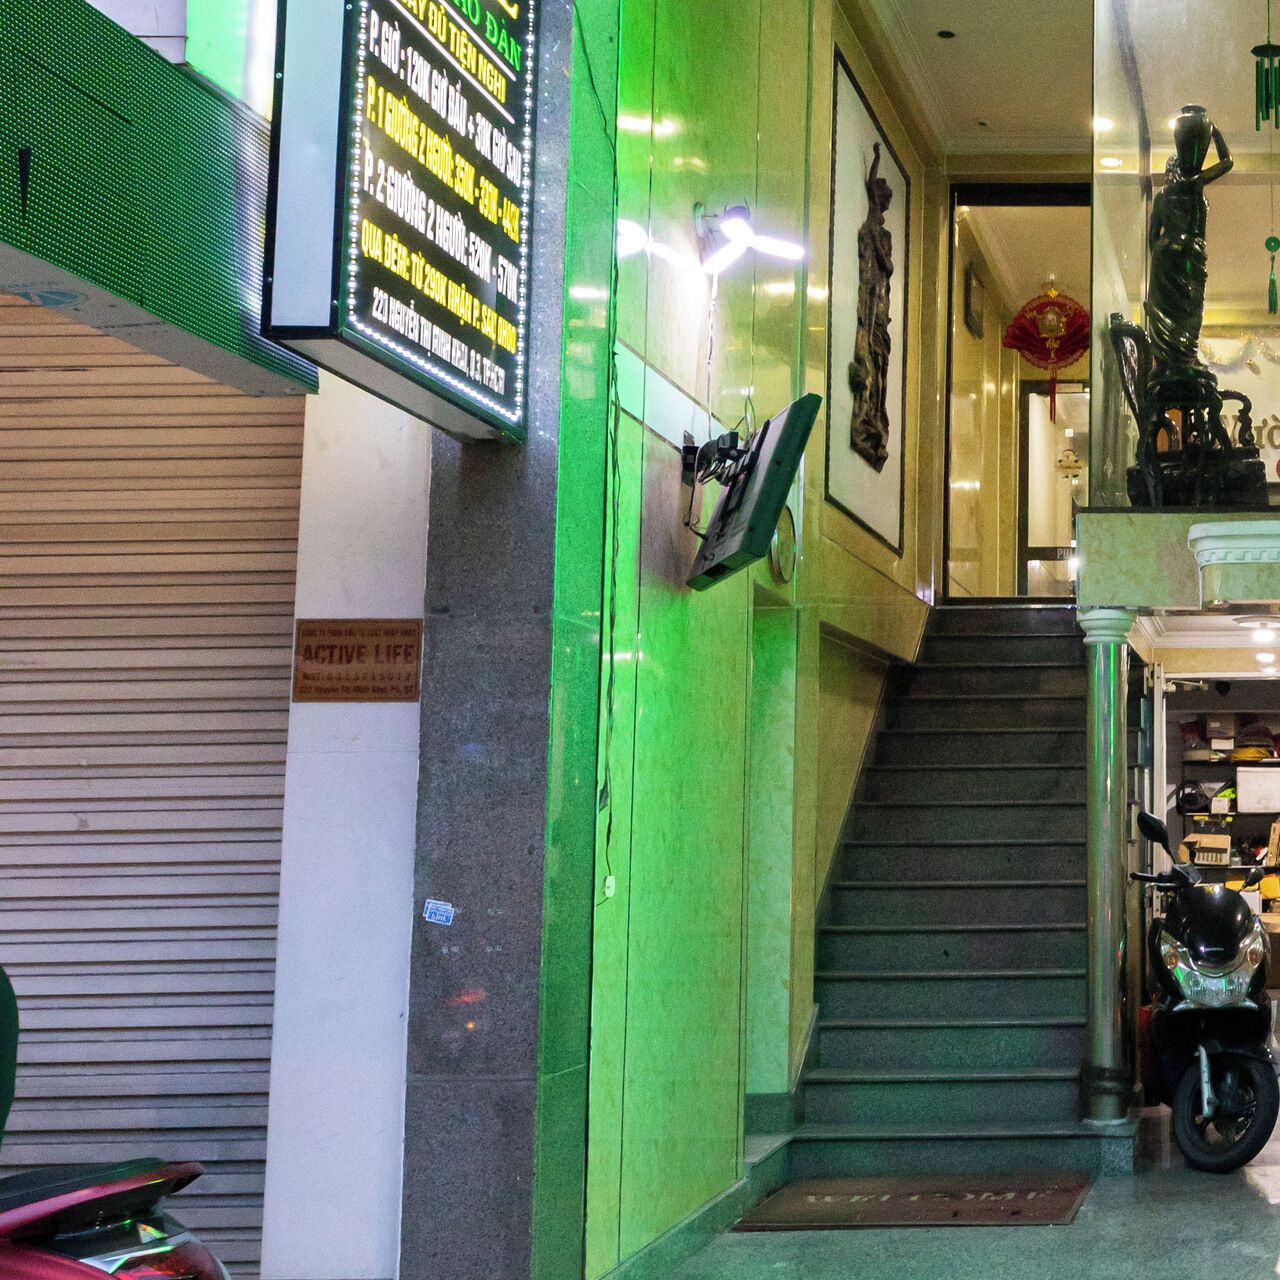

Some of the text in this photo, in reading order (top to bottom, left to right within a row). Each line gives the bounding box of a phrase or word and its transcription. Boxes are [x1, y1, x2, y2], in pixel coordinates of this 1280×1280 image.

[381, 21, 400, 74] GIỜ
[407, 47, 431, 103] 120K
[428, 4, 448, 43] ĐỦ
[448, 22, 477, 74] TIỆN
[478, 54, 506, 104] NGHI
[485, 10, 522, 71] ĐÀN
[361, 219, 383, 263] QUA
[302, 644, 416, 665] ACTIVE LIFE
